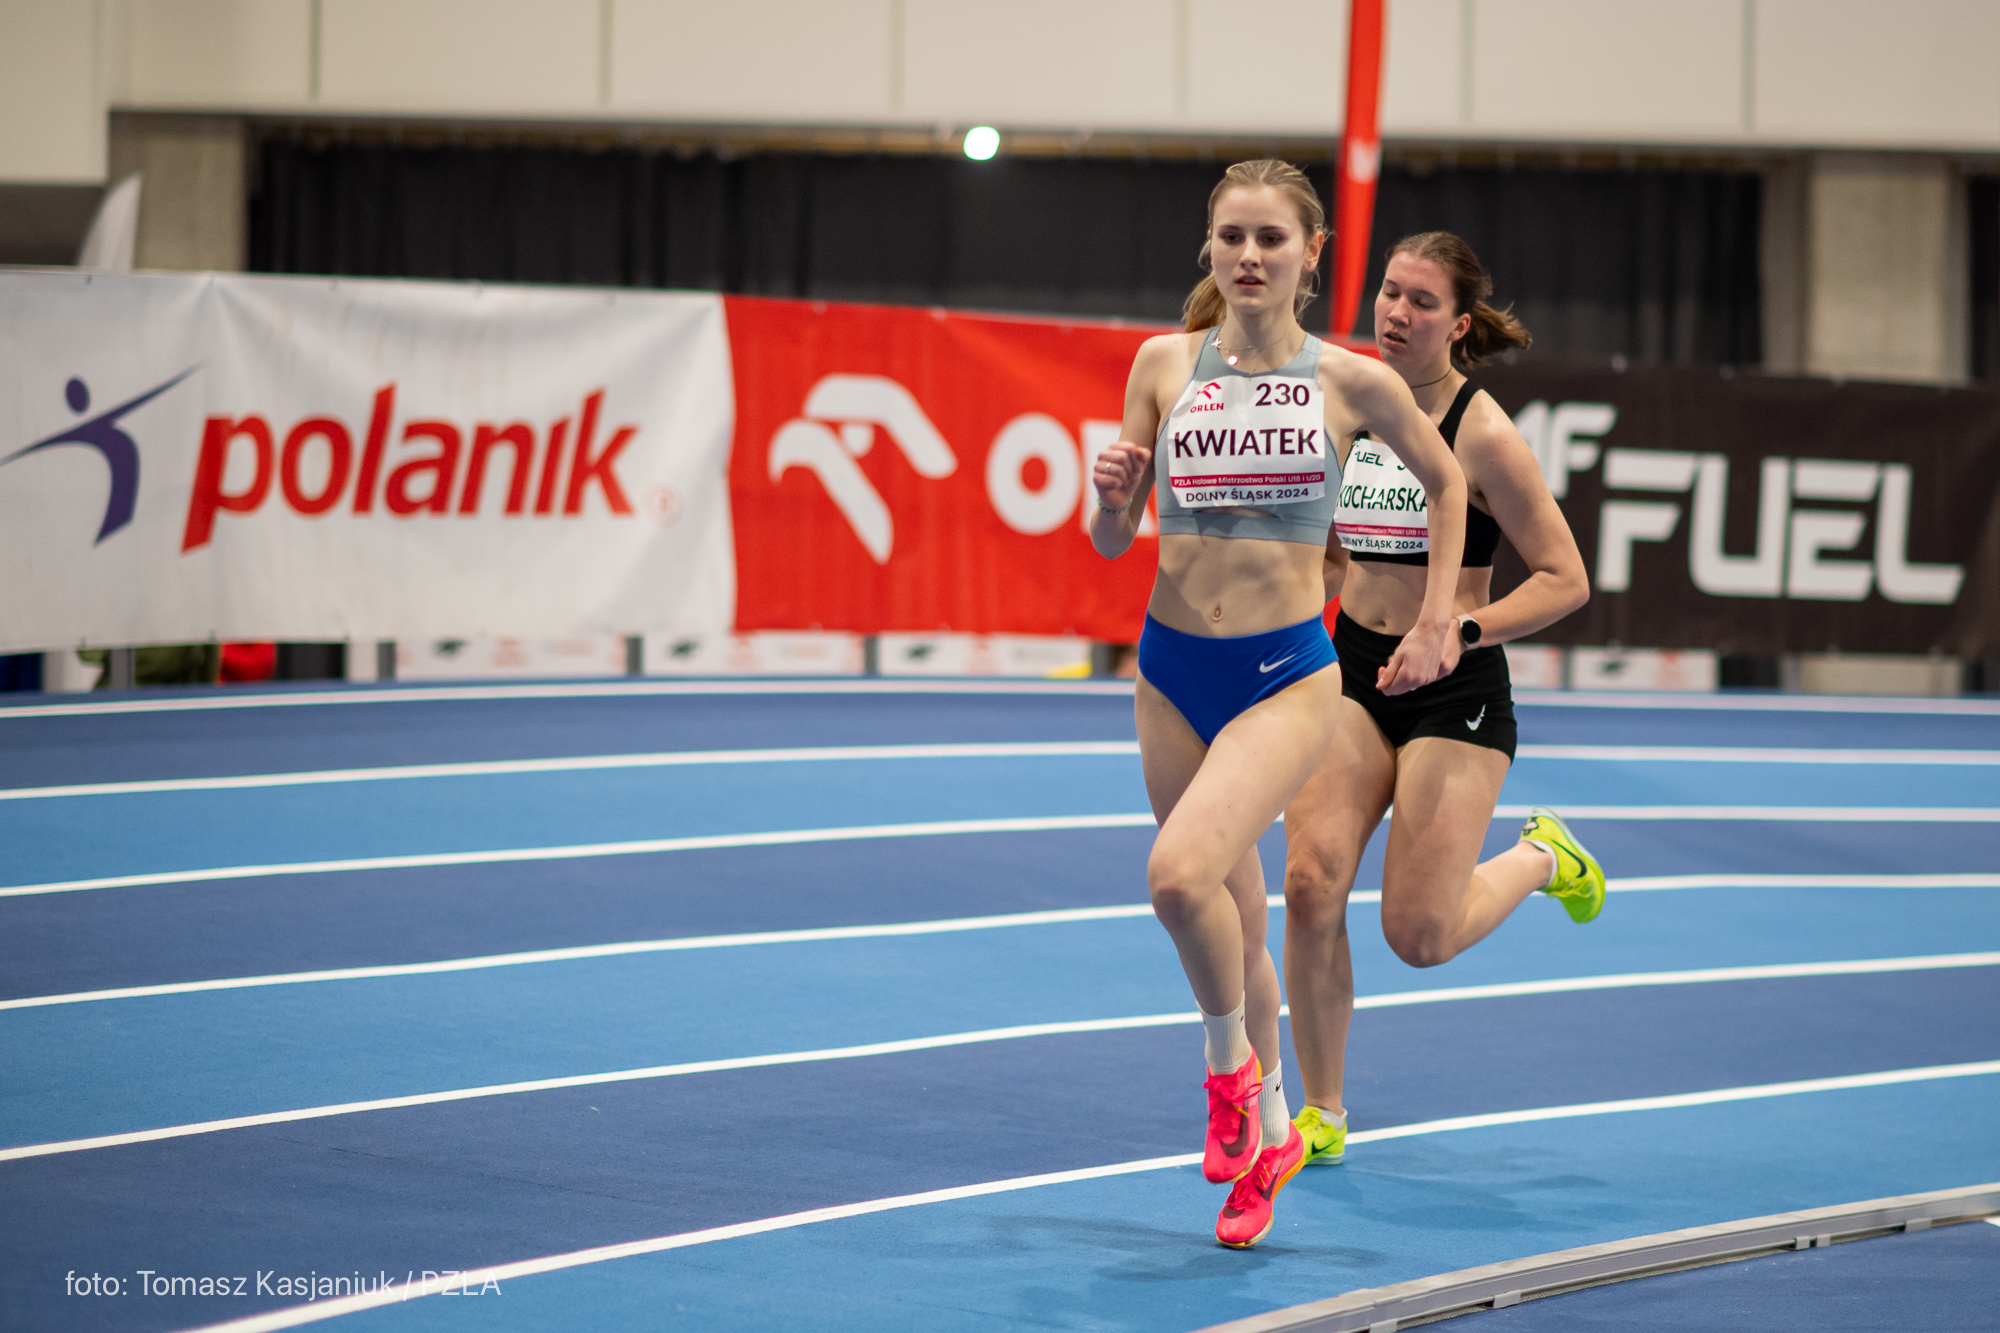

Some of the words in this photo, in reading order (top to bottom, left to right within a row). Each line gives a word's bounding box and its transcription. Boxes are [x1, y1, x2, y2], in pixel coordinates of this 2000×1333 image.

[1255, 383, 1310, 407] 230
[1190, 402, 1224, 413] ORLEN
[1174, 428, 1318, 459] KWIATEK
[1355, 451, 1384, 466] UEL
[180, 381, 642, 556] polanik
[1218, 476, 1263, 484] Mistrzostwa
[1265, 475, 1286, 483] Polski
[1287, 475, 1300, 483] U18
[1306, 474, 1321, 482] U20
[1186, 490, 1227, 502] DOLNY
[1231, 488, 1273, 502] ŚLĄSK
[1276, 488, 1309, 499] 2024
[1596, 447, 1964, 605] FUEL
[1365, 536, 1392, 550] ŚLĄSK
[1395, 540, 1423, 549] 2024
